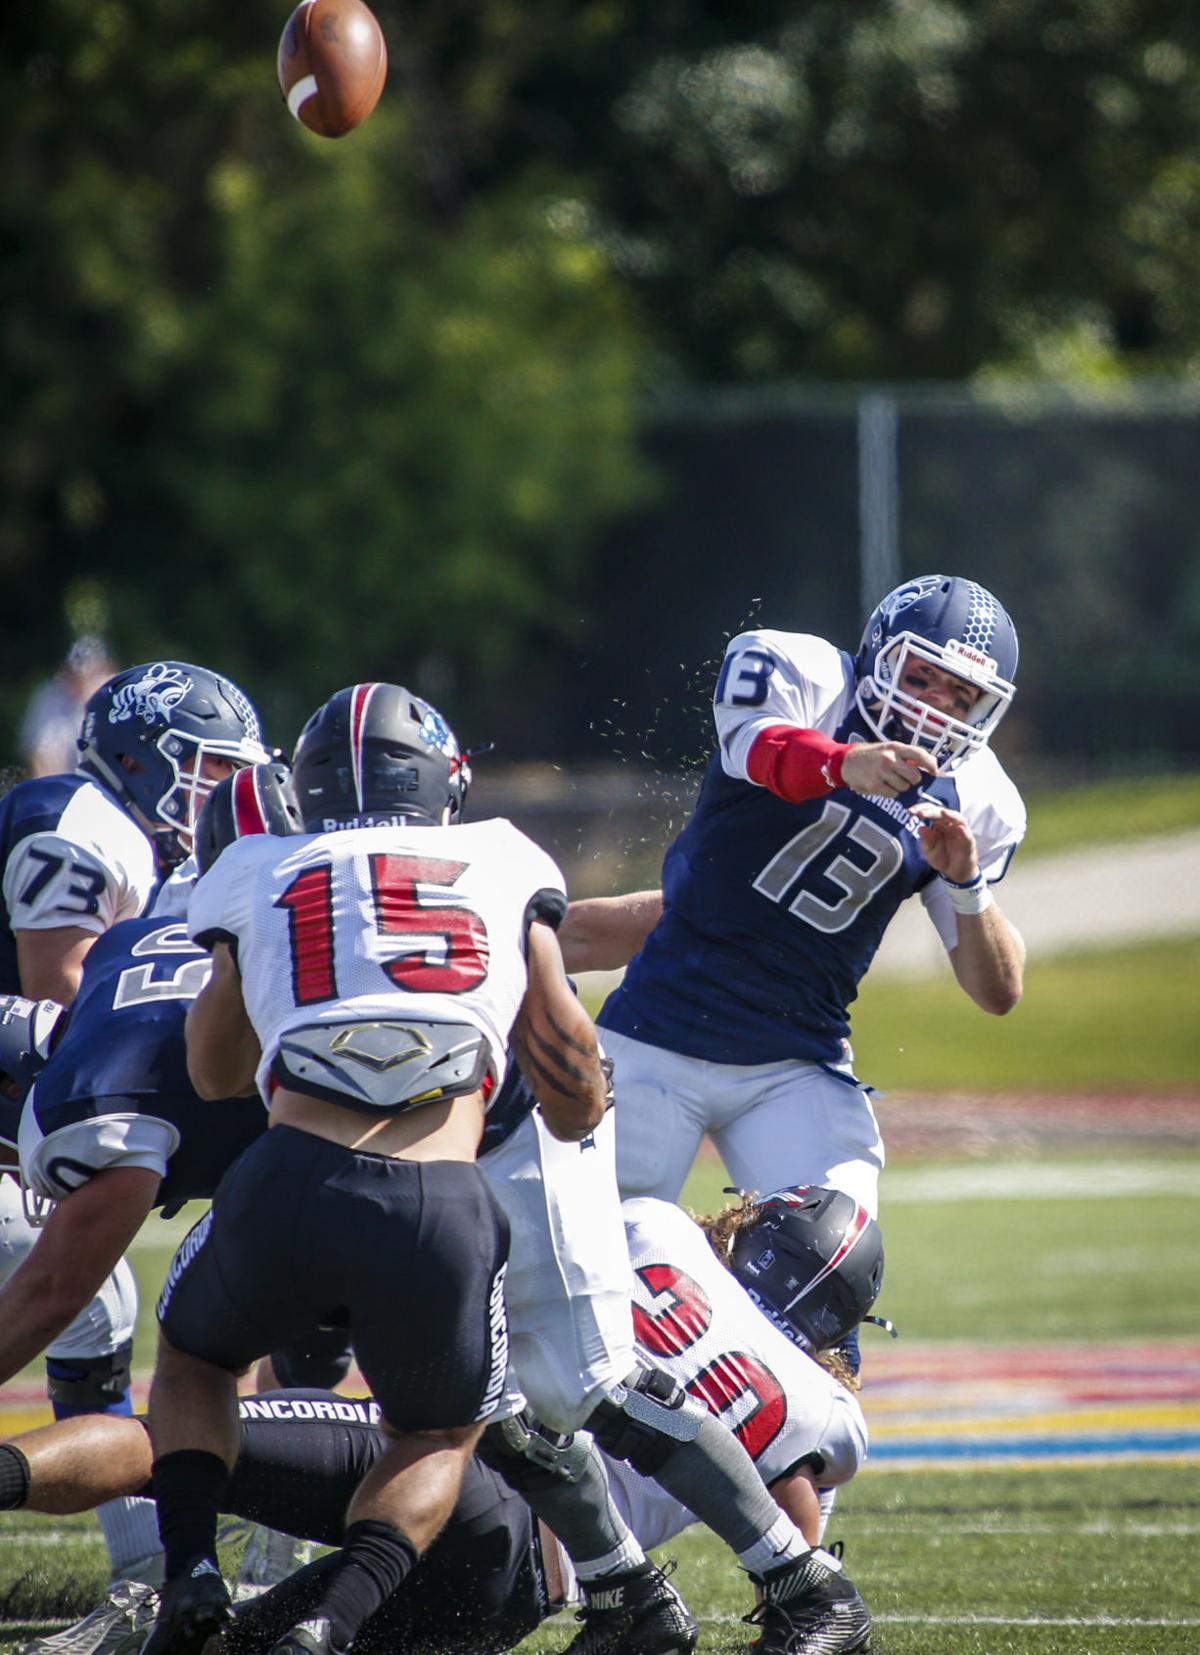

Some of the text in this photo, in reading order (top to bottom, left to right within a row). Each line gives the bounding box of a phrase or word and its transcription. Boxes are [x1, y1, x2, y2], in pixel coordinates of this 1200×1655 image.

[715, 649, 776, 707] 13
[19, 847, 107, 916] 73
[752, 799, 904, 934] 13
[272, 853, 490, 1008] 15
[474, 1261, 509, 1423] CONCORDIA
[590, 1586, 625, 1610] NIKE
